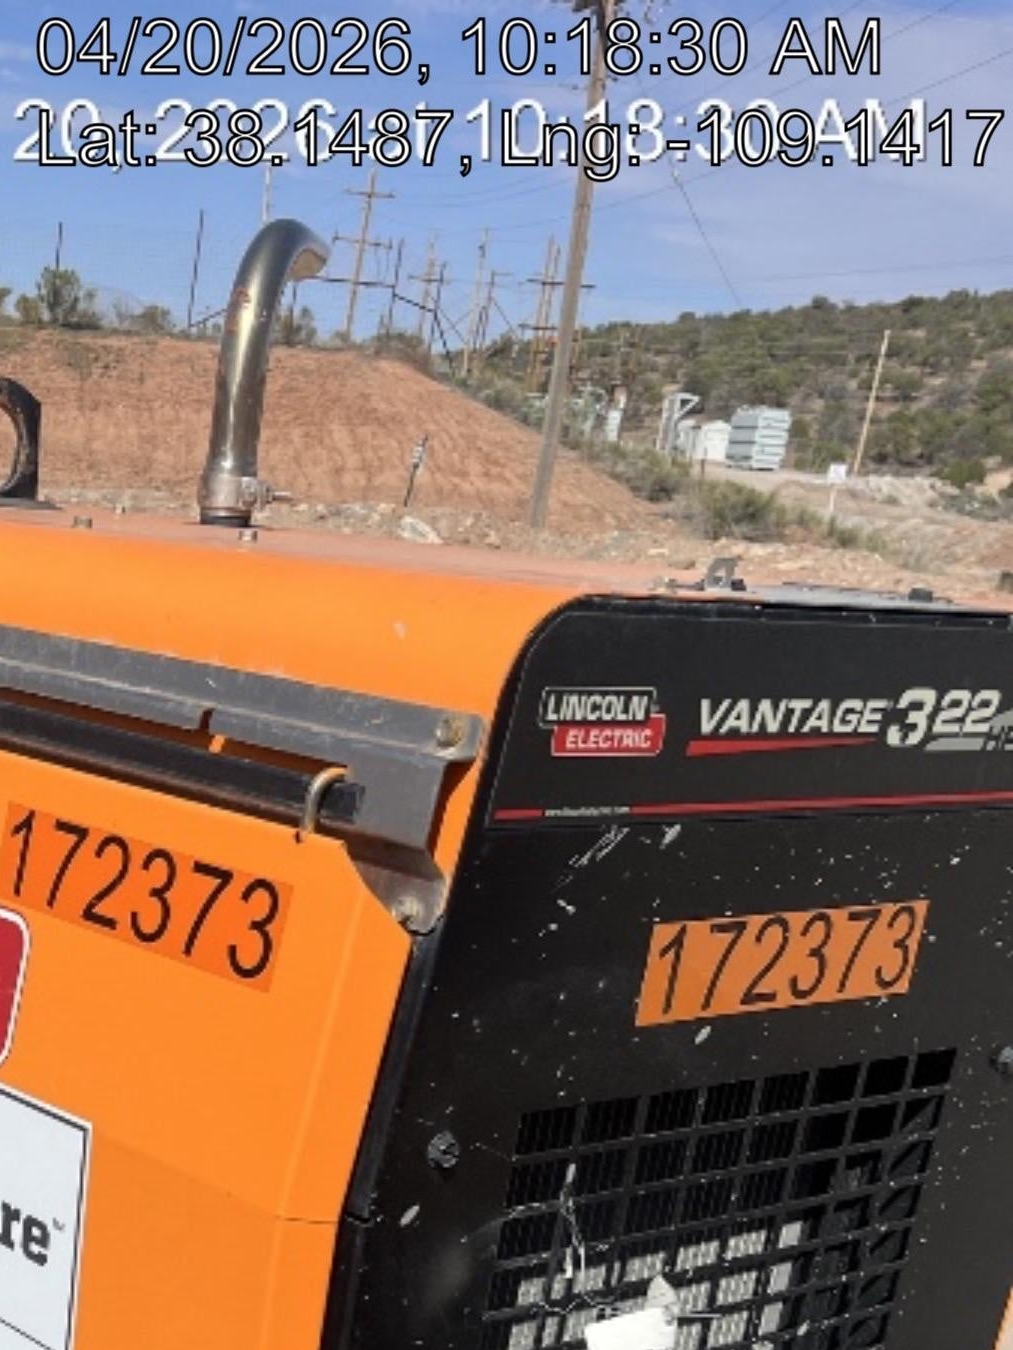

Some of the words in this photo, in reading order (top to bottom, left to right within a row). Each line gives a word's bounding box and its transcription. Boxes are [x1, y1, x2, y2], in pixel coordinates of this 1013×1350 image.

[545, 695, 649, 721] LINCOLN
[565, 728, 652, 749] ELECTRIC
[700, 698, 888, 734] VANTAGE
[887, 687, 1001, 748] 322
[8, 810, 281, 980] 172373
[657, 906, 916, 1015] 172373
